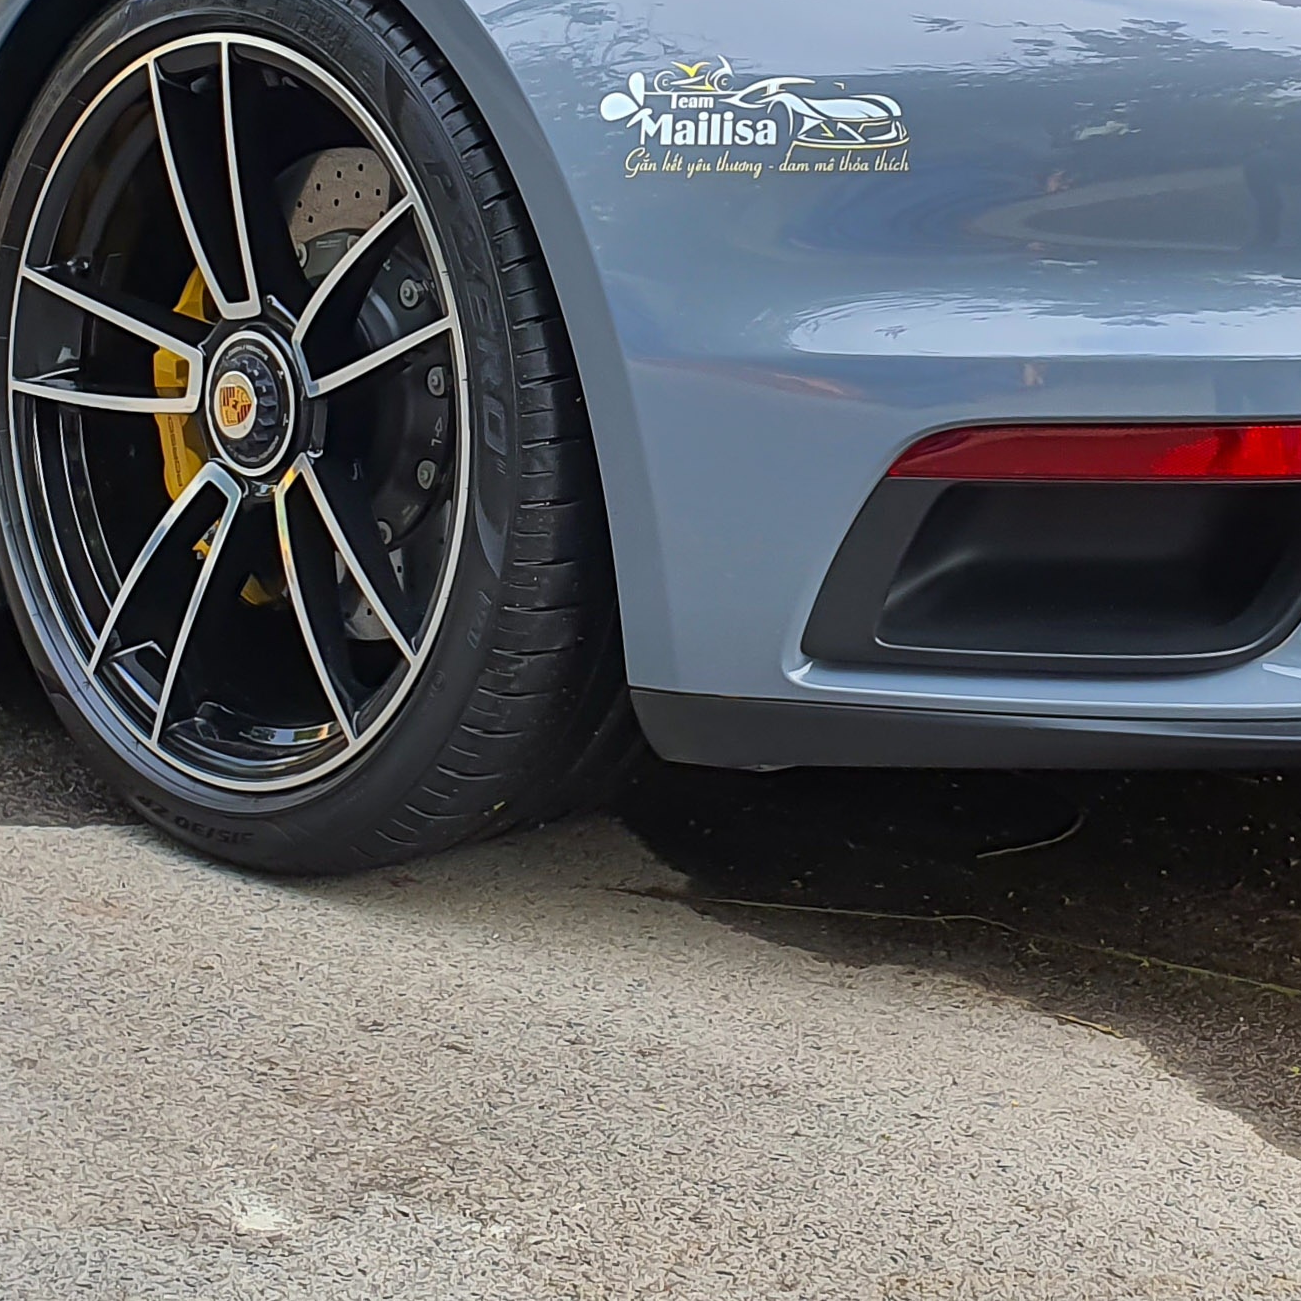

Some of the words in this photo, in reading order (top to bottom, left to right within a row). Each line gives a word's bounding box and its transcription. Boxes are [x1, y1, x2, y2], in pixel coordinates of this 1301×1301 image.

[669, 92, 715, 110] Team
[639, 109, 778, 146] Mailisa
[625, 146, 658, 178] Gắn
[662, 149, 683, 172] kết
[686, 158, 712, 179] yêu
[716, 150, 763, 179] thương
[814, 157, 836, 172] mê
[874, 149, 910, 172] thích
